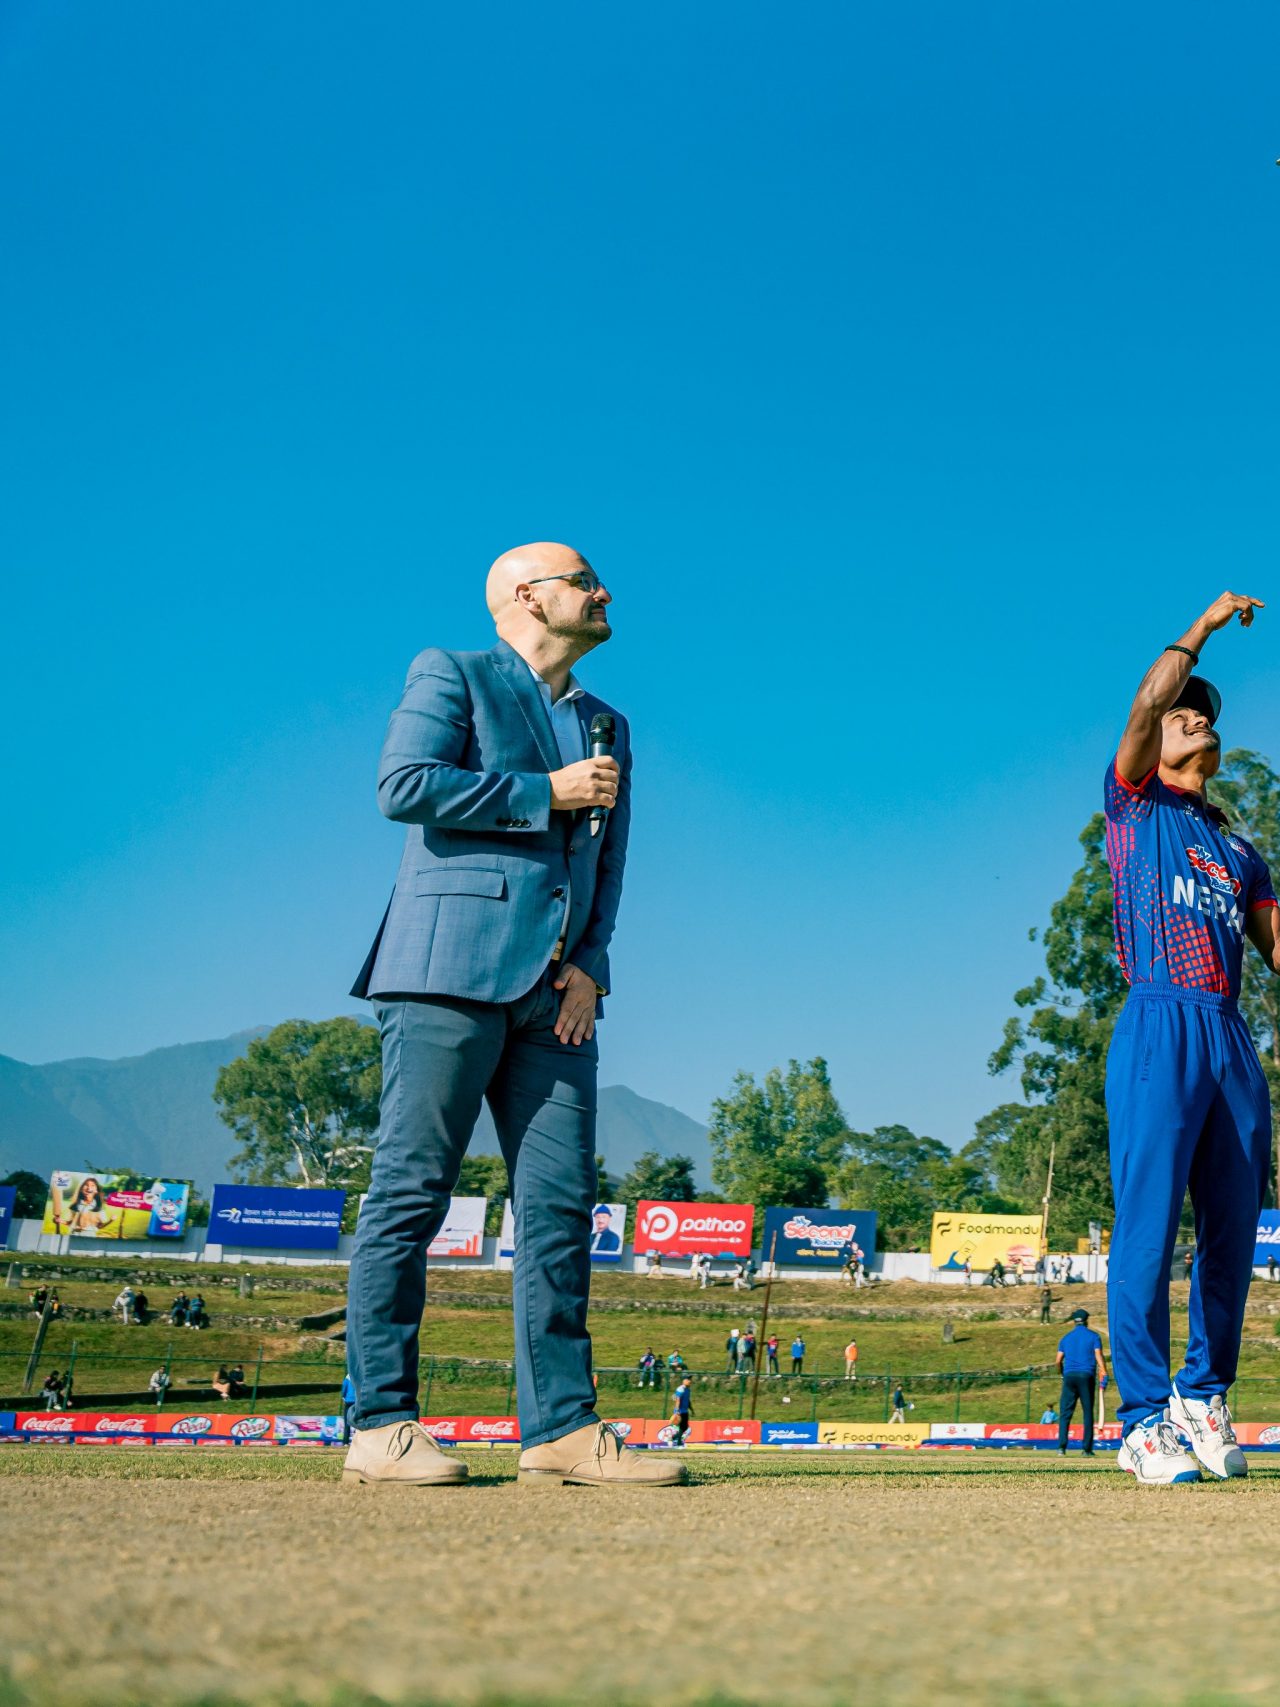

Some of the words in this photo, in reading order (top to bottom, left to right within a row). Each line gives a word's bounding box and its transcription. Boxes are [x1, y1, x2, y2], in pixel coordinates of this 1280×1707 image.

[1173, 875, 1245, 936] NEPA
[680, 1216, 747, 1234] pathao
[783, 1220, 857, 1241] Second
[958, 1222, 1040, 1235] Foodmandu
[843, 1432, 918, 1442] Foodmandu
